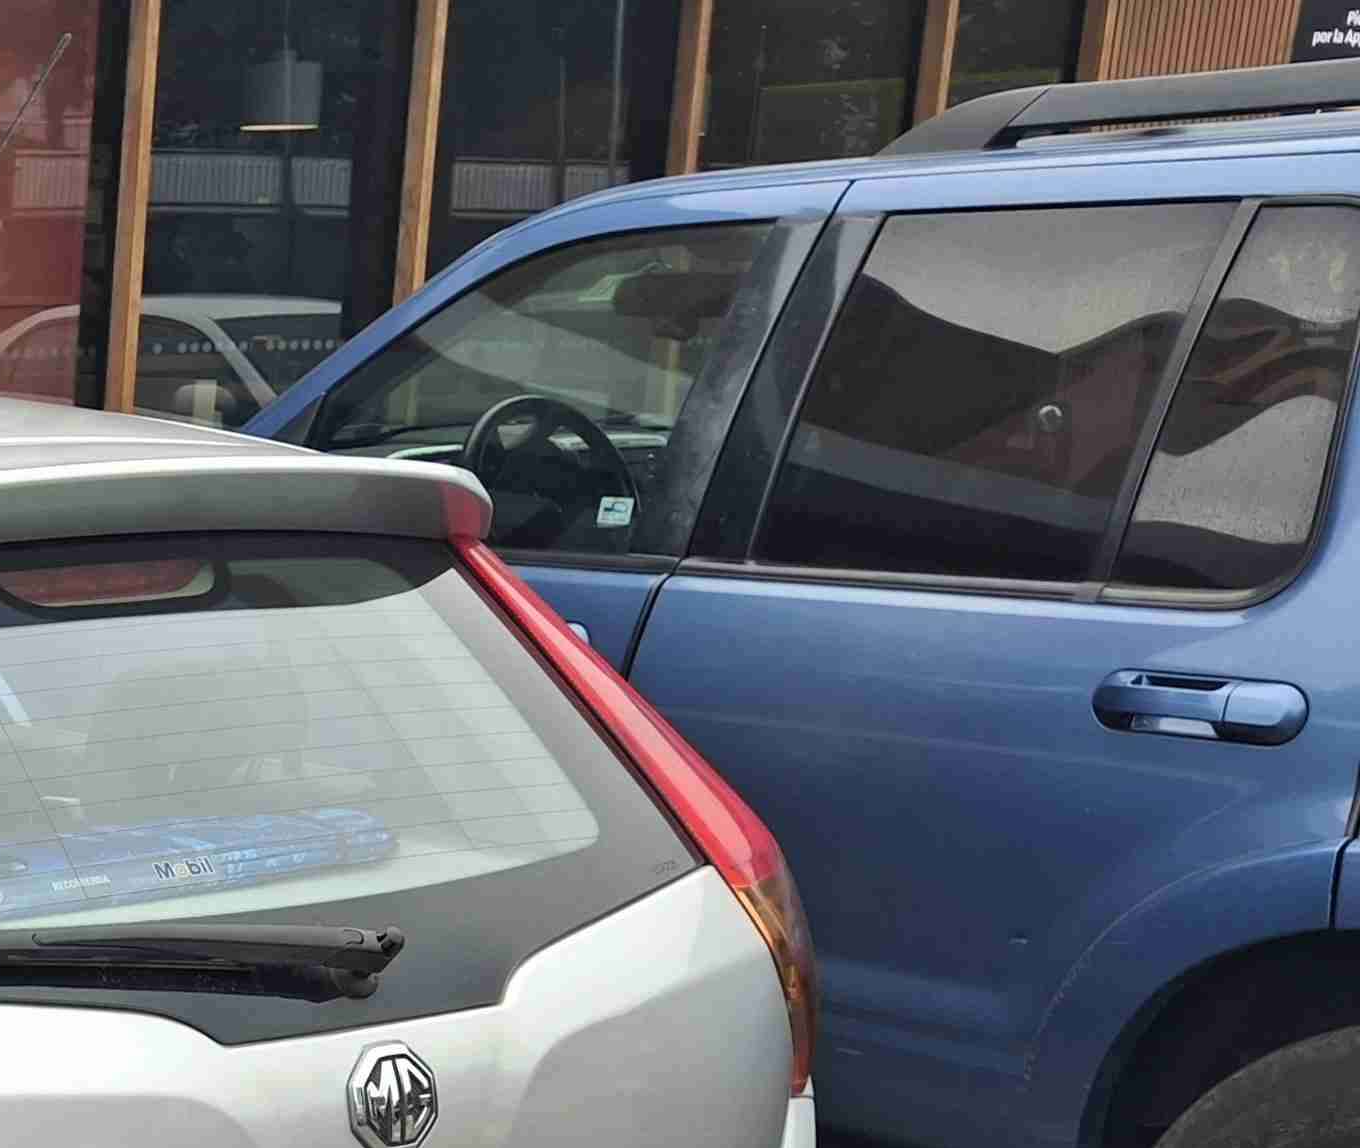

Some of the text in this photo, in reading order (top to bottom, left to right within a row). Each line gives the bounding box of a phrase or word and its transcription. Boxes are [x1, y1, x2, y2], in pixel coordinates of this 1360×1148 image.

[1311, 27, 1360, 48] por la Ap
[153, 855, 215, 880] Mobil
[362, 1053, 433, 1147] MG
